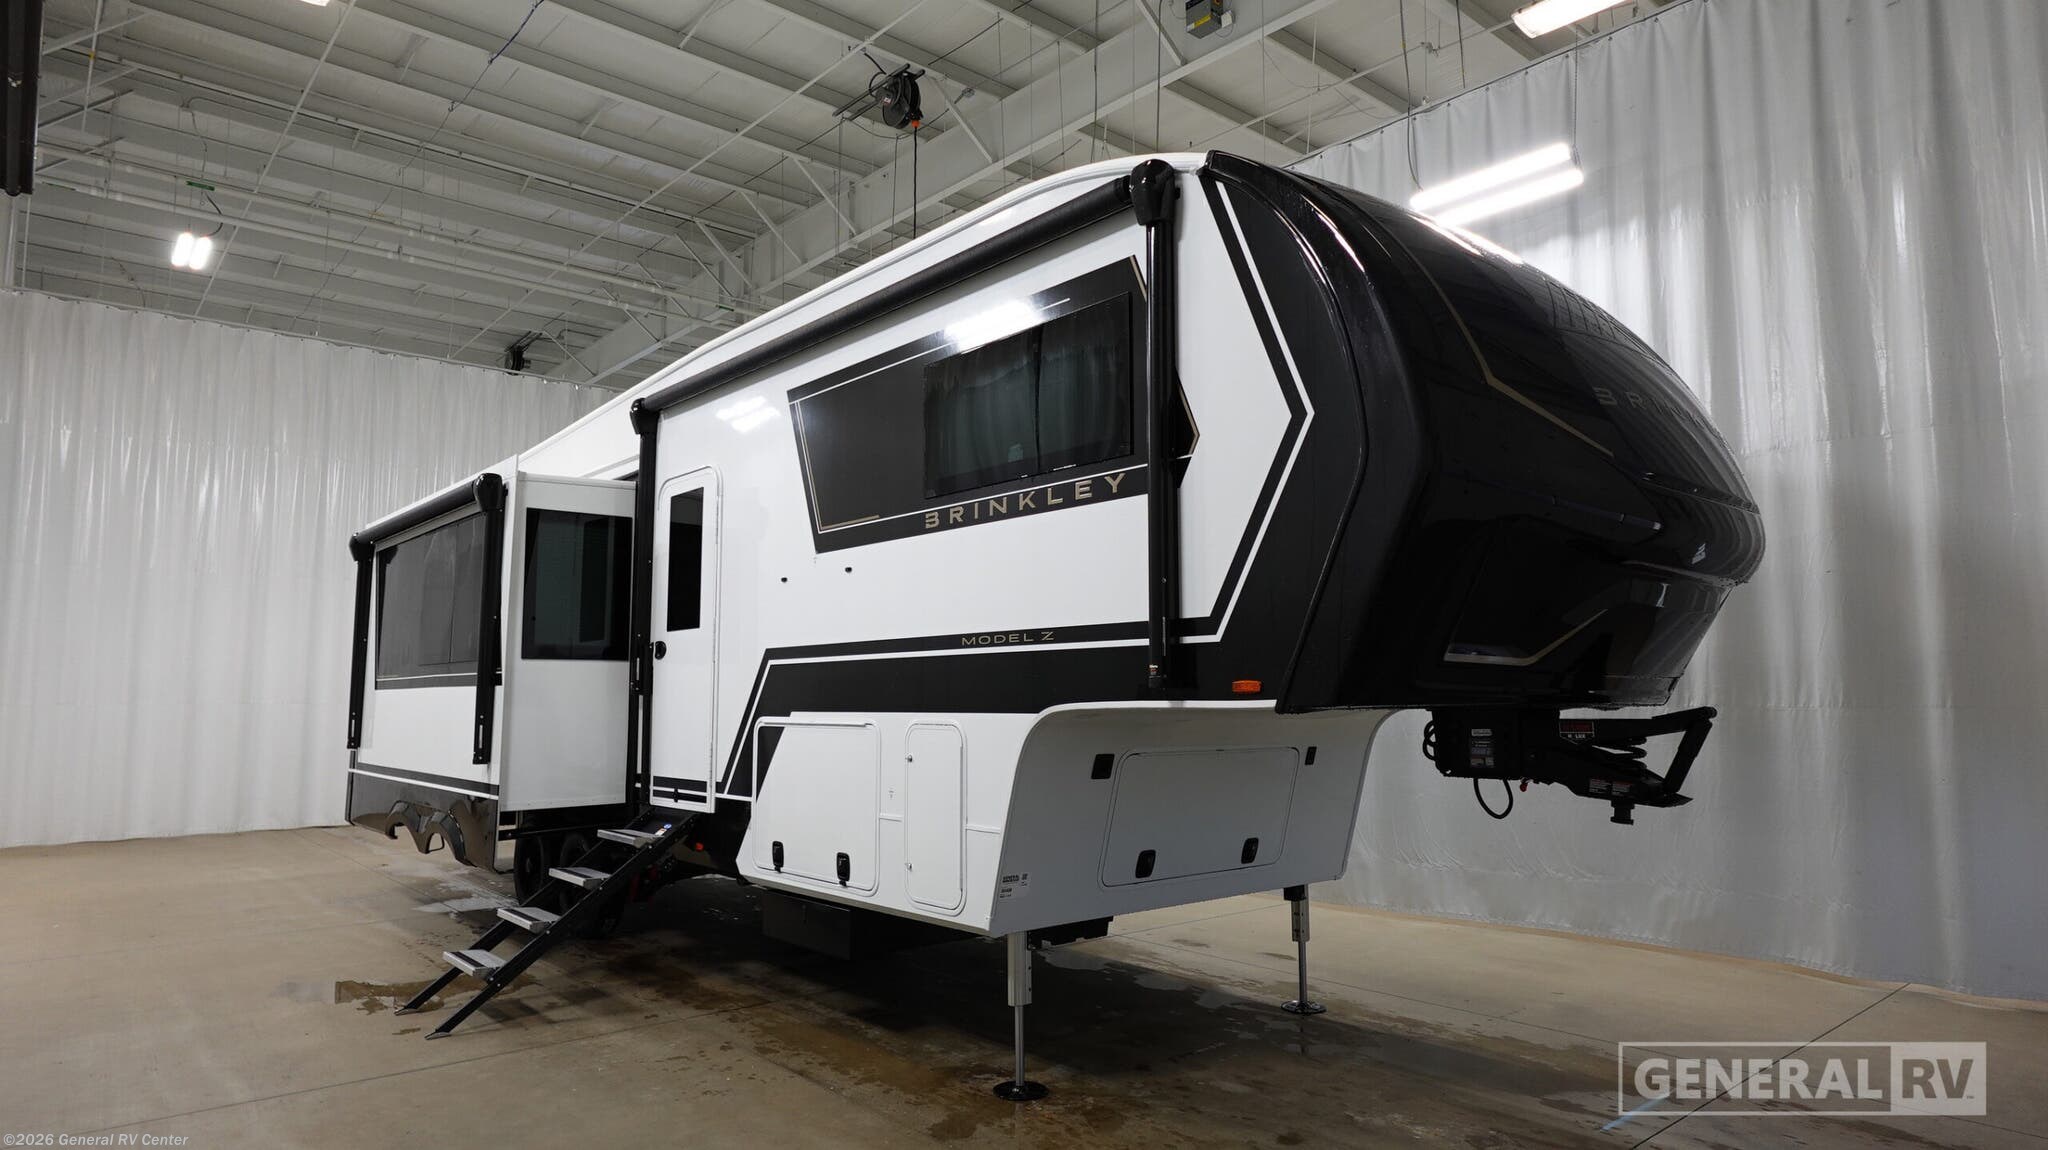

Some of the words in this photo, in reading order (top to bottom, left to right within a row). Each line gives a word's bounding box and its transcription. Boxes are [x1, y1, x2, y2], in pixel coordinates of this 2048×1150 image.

[925, 473, 1125, 529] BRINKLEY
[961, 633, 1034, 646] MODEL
[1041, 631, 1055, 641] Z
